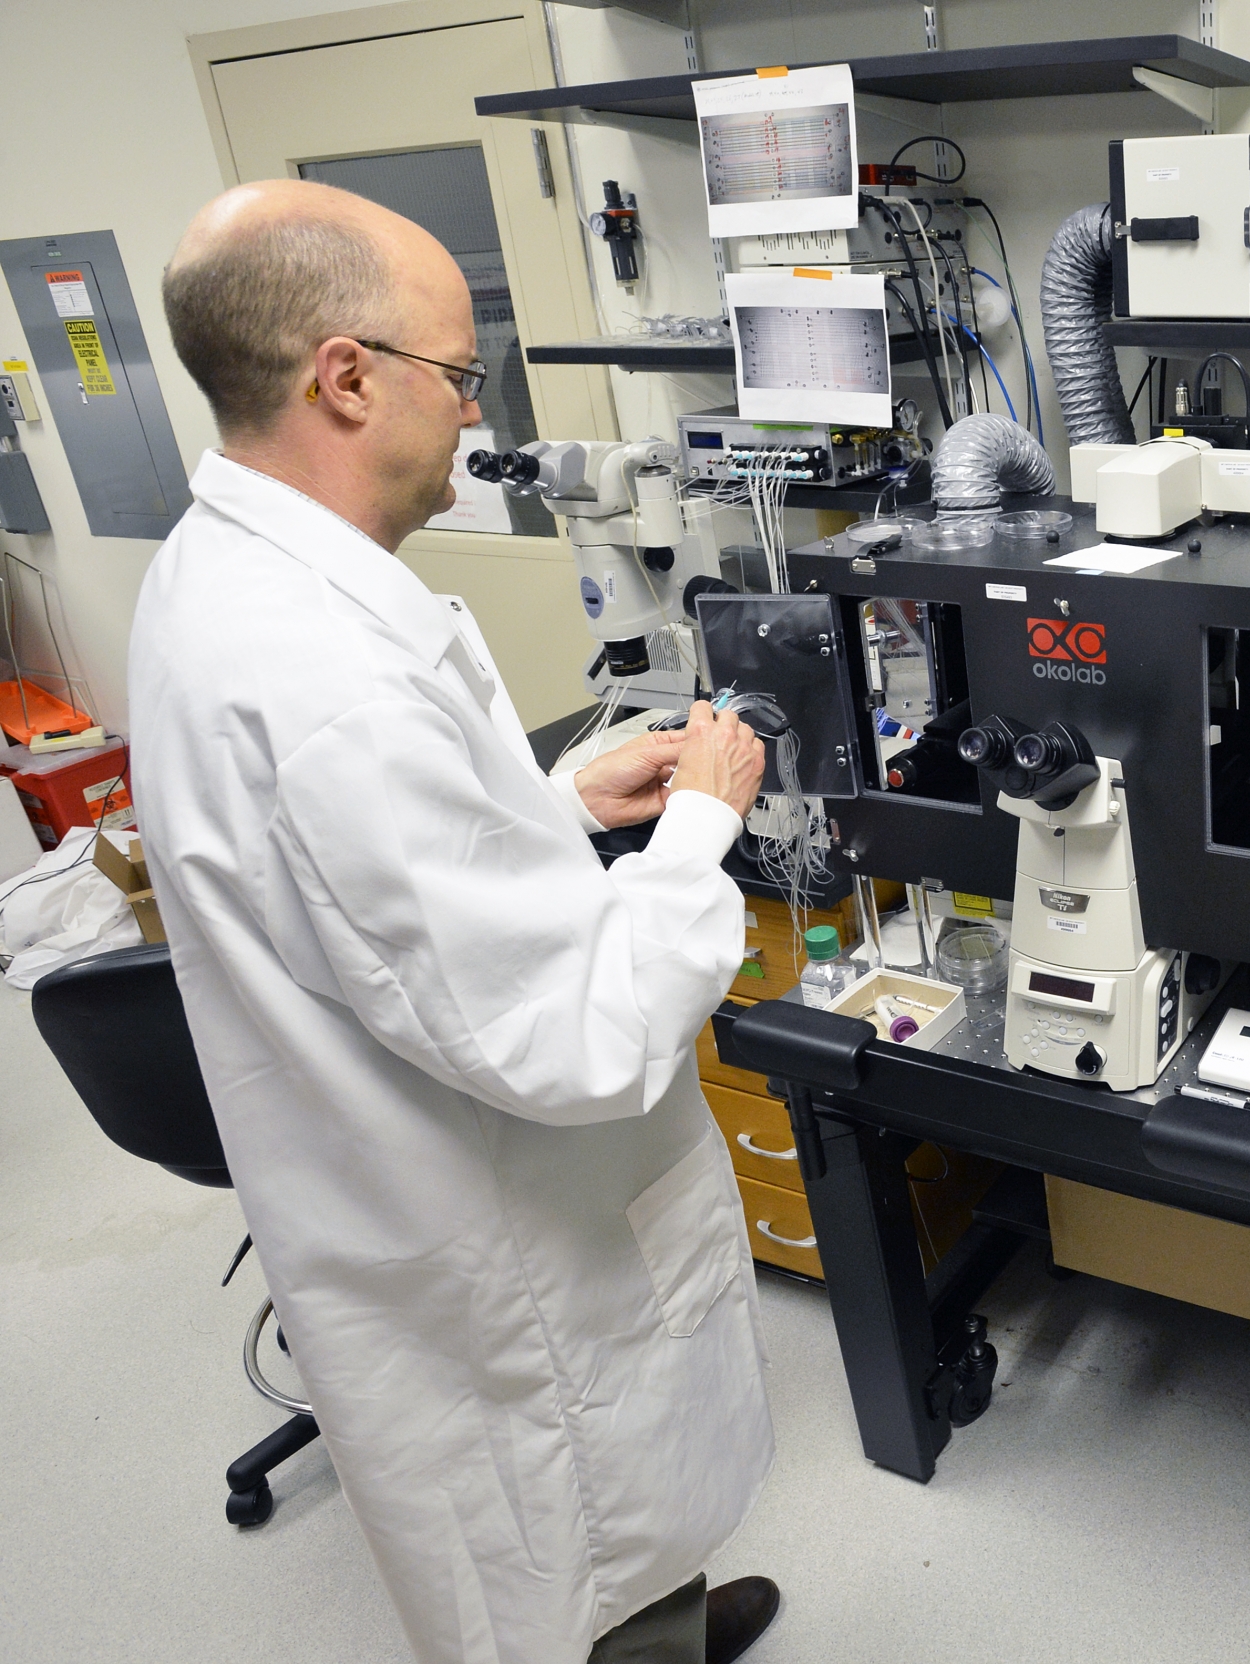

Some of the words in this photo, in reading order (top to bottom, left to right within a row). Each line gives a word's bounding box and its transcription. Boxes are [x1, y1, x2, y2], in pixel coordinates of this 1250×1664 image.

[67, 323, 94, 332] CAUTION
[1033, 660, 1106, 685] okolab
[1053, 893, 1071, 901] Nikon
